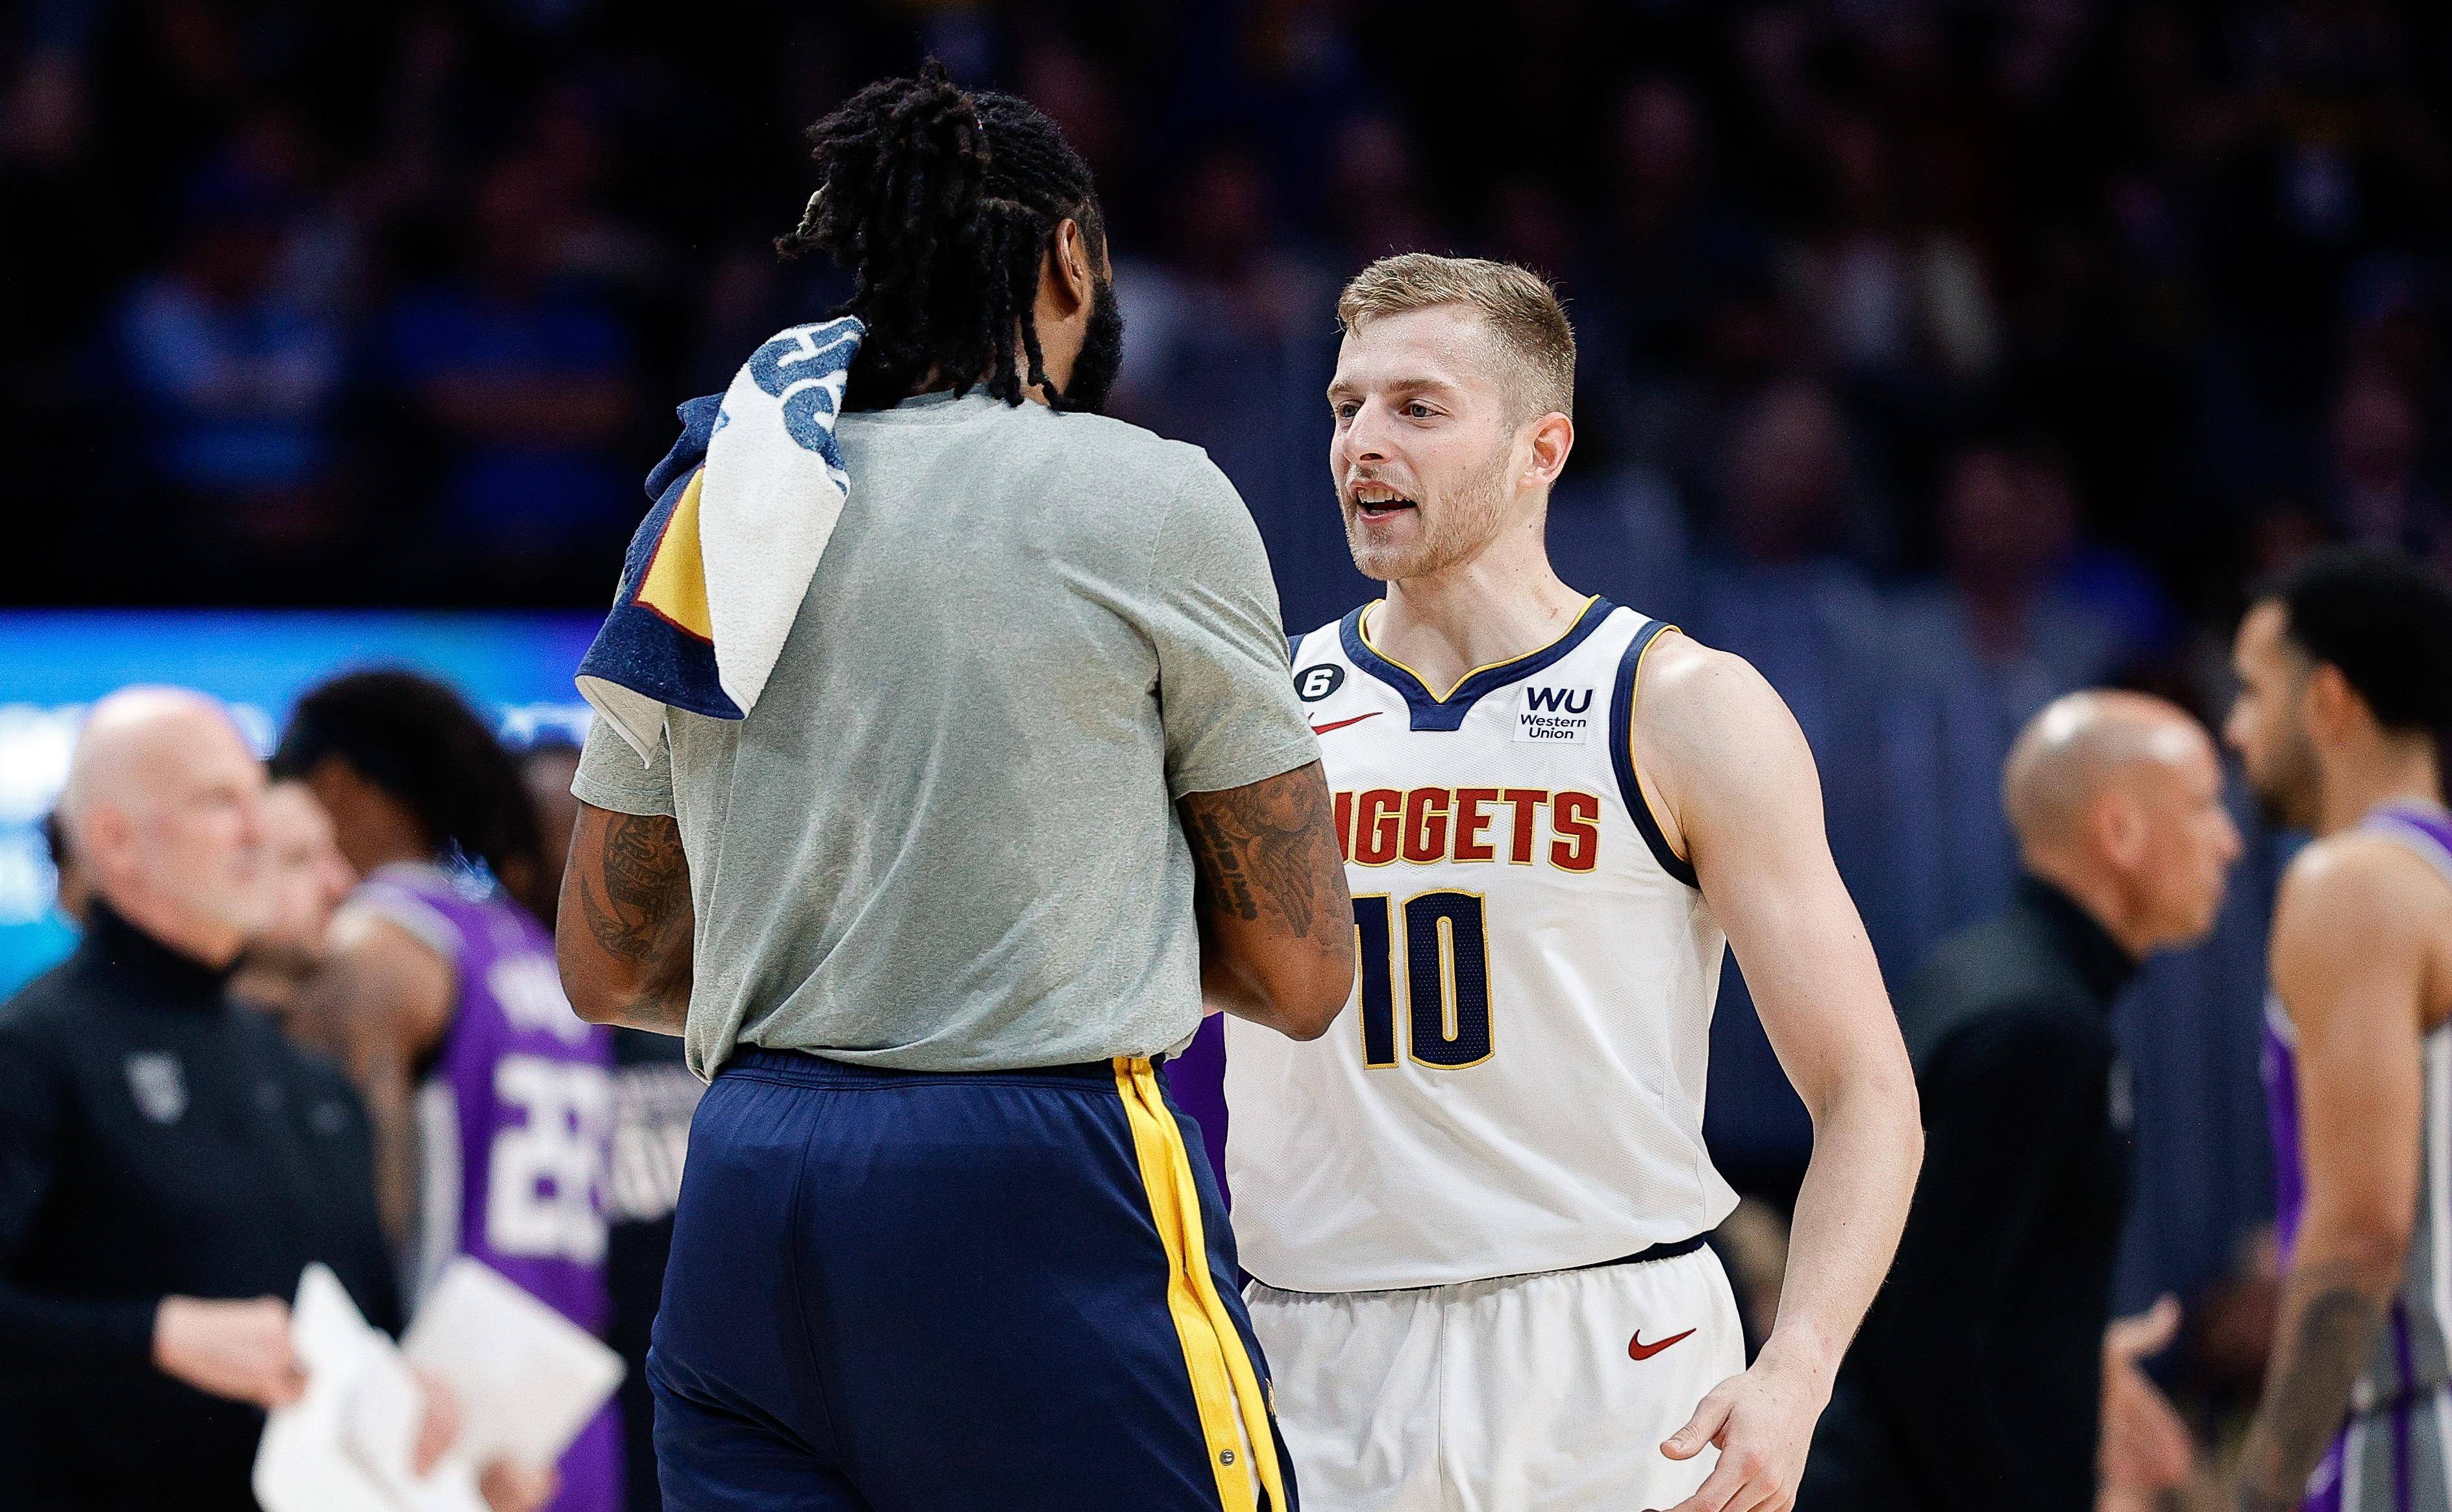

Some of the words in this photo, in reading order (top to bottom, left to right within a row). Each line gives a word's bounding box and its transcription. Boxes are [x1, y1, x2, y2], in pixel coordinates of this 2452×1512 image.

[1302, 668, 1333, 697] 6
[1526, 686, 1594, 714] WU
[1520, 713, 1587, 728] Western
[1529, 726, 1574, 739] Union
[1350, 887, 1495, 1071] 10
